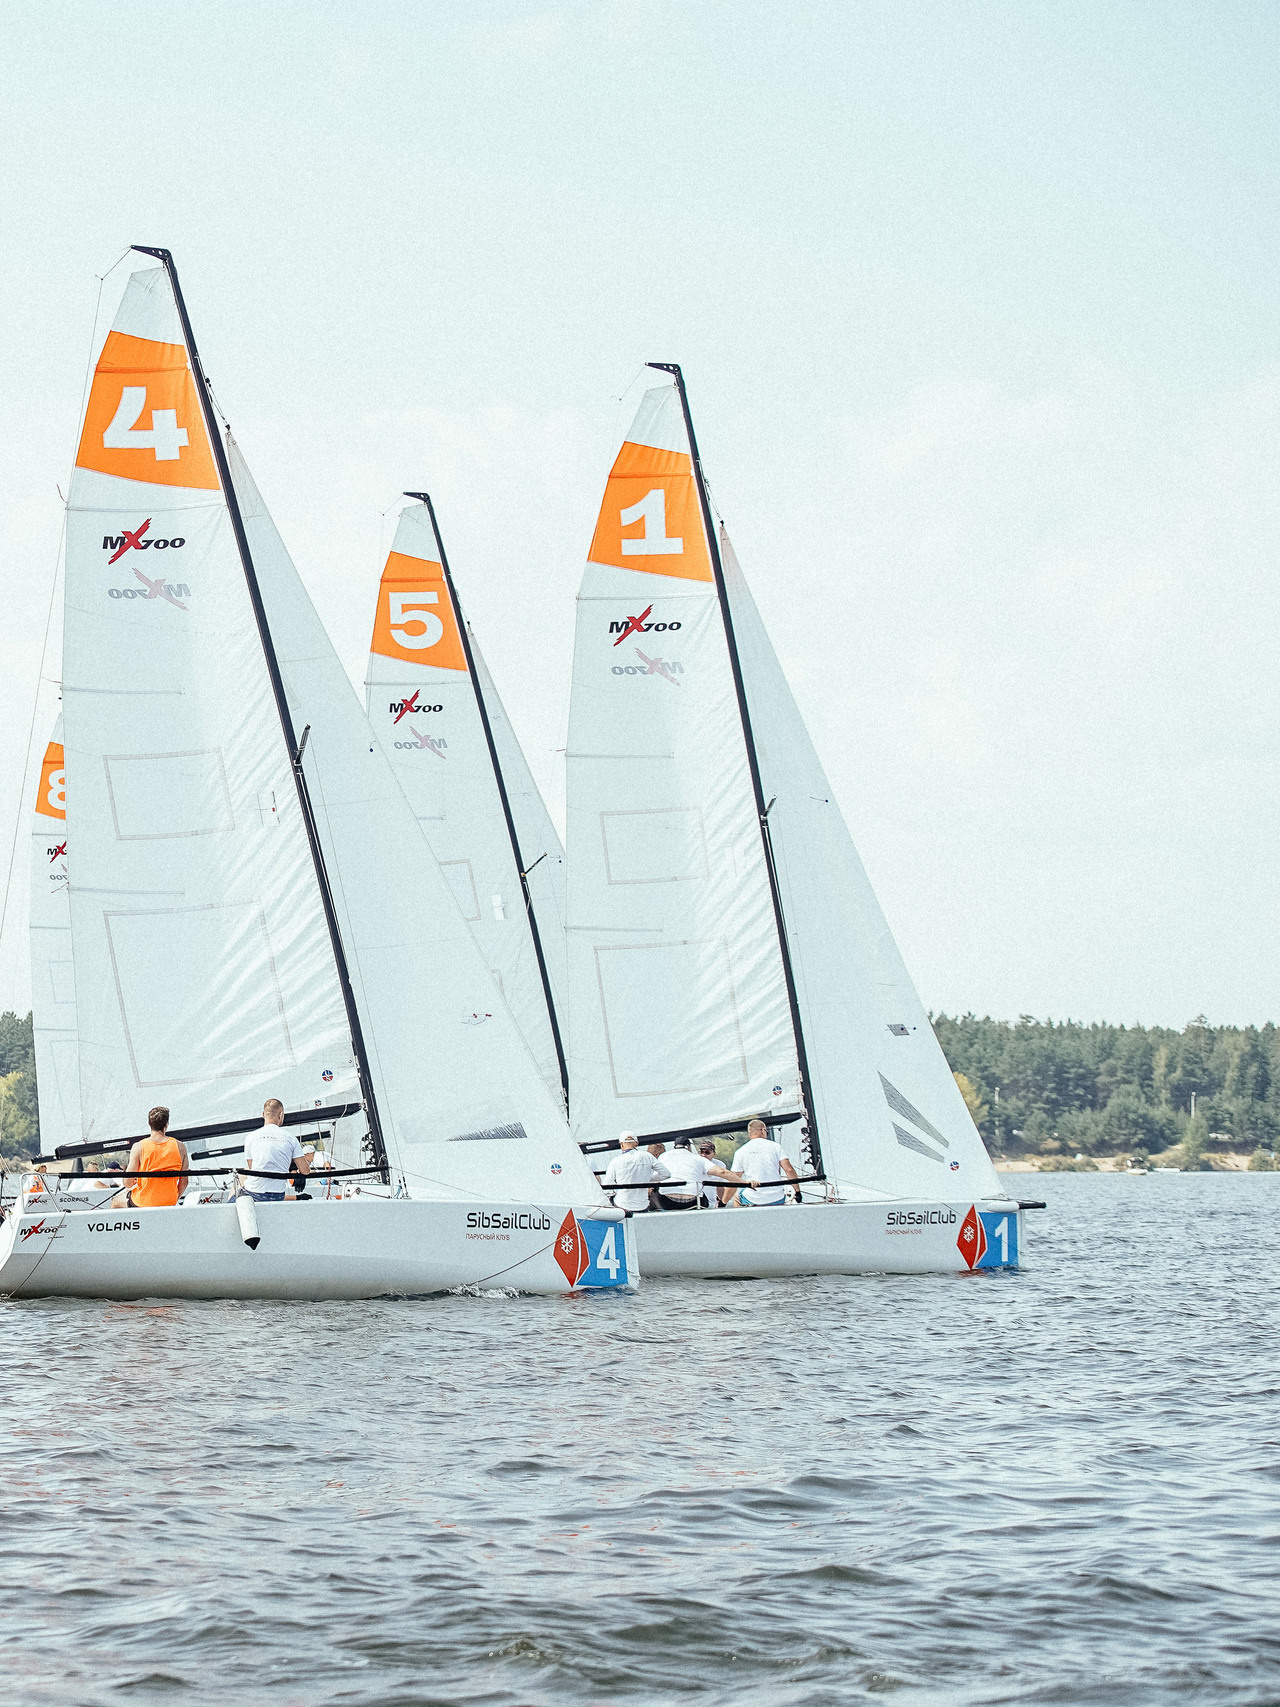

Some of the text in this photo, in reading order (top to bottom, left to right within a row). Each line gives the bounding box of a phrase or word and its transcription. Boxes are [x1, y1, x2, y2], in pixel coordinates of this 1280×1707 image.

[103, 386, 190, 461] 4
[102, 517, 186, 566] MX700
[620, 488, 684, 556] 1
[388, 591, 444, 650] 5
[608, 603, 682, 647] MX700
[388, 689, 444, 725] MX700
[87, 1221, 140, 1232] VOLANS
[466, 1212, 551, 1230] SibSailClub
[466, 1232, 511, 1241] ПАРУСНЫЙ КЛУБ
[886, 1210, 957, 1225] SibSailClub
[995, 1216, 1009, 1262] 1
[596, 1226, 621, 1280] 4
